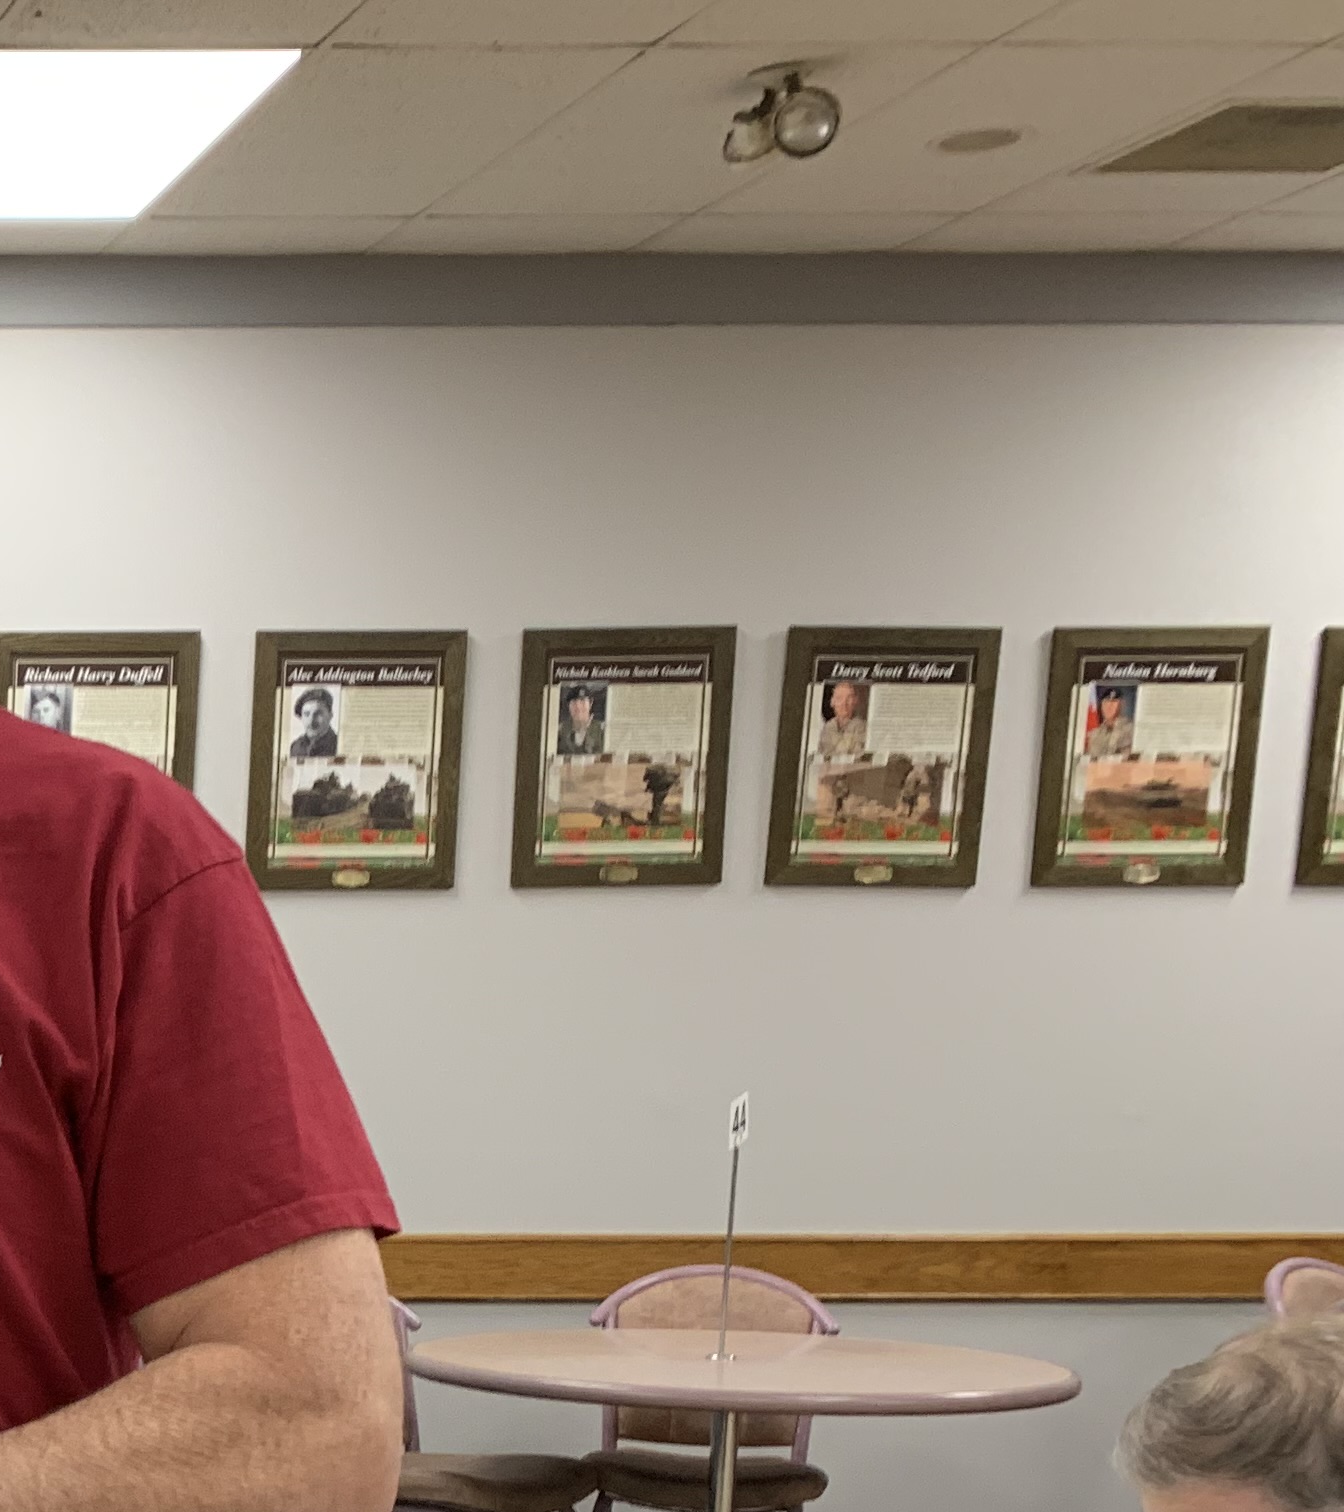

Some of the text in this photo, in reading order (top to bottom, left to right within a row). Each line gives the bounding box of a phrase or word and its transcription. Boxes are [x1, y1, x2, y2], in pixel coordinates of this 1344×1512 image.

[24, 665, 164, 686] Richard Harry Duffell
[314, 666, 375, 684] Addington
